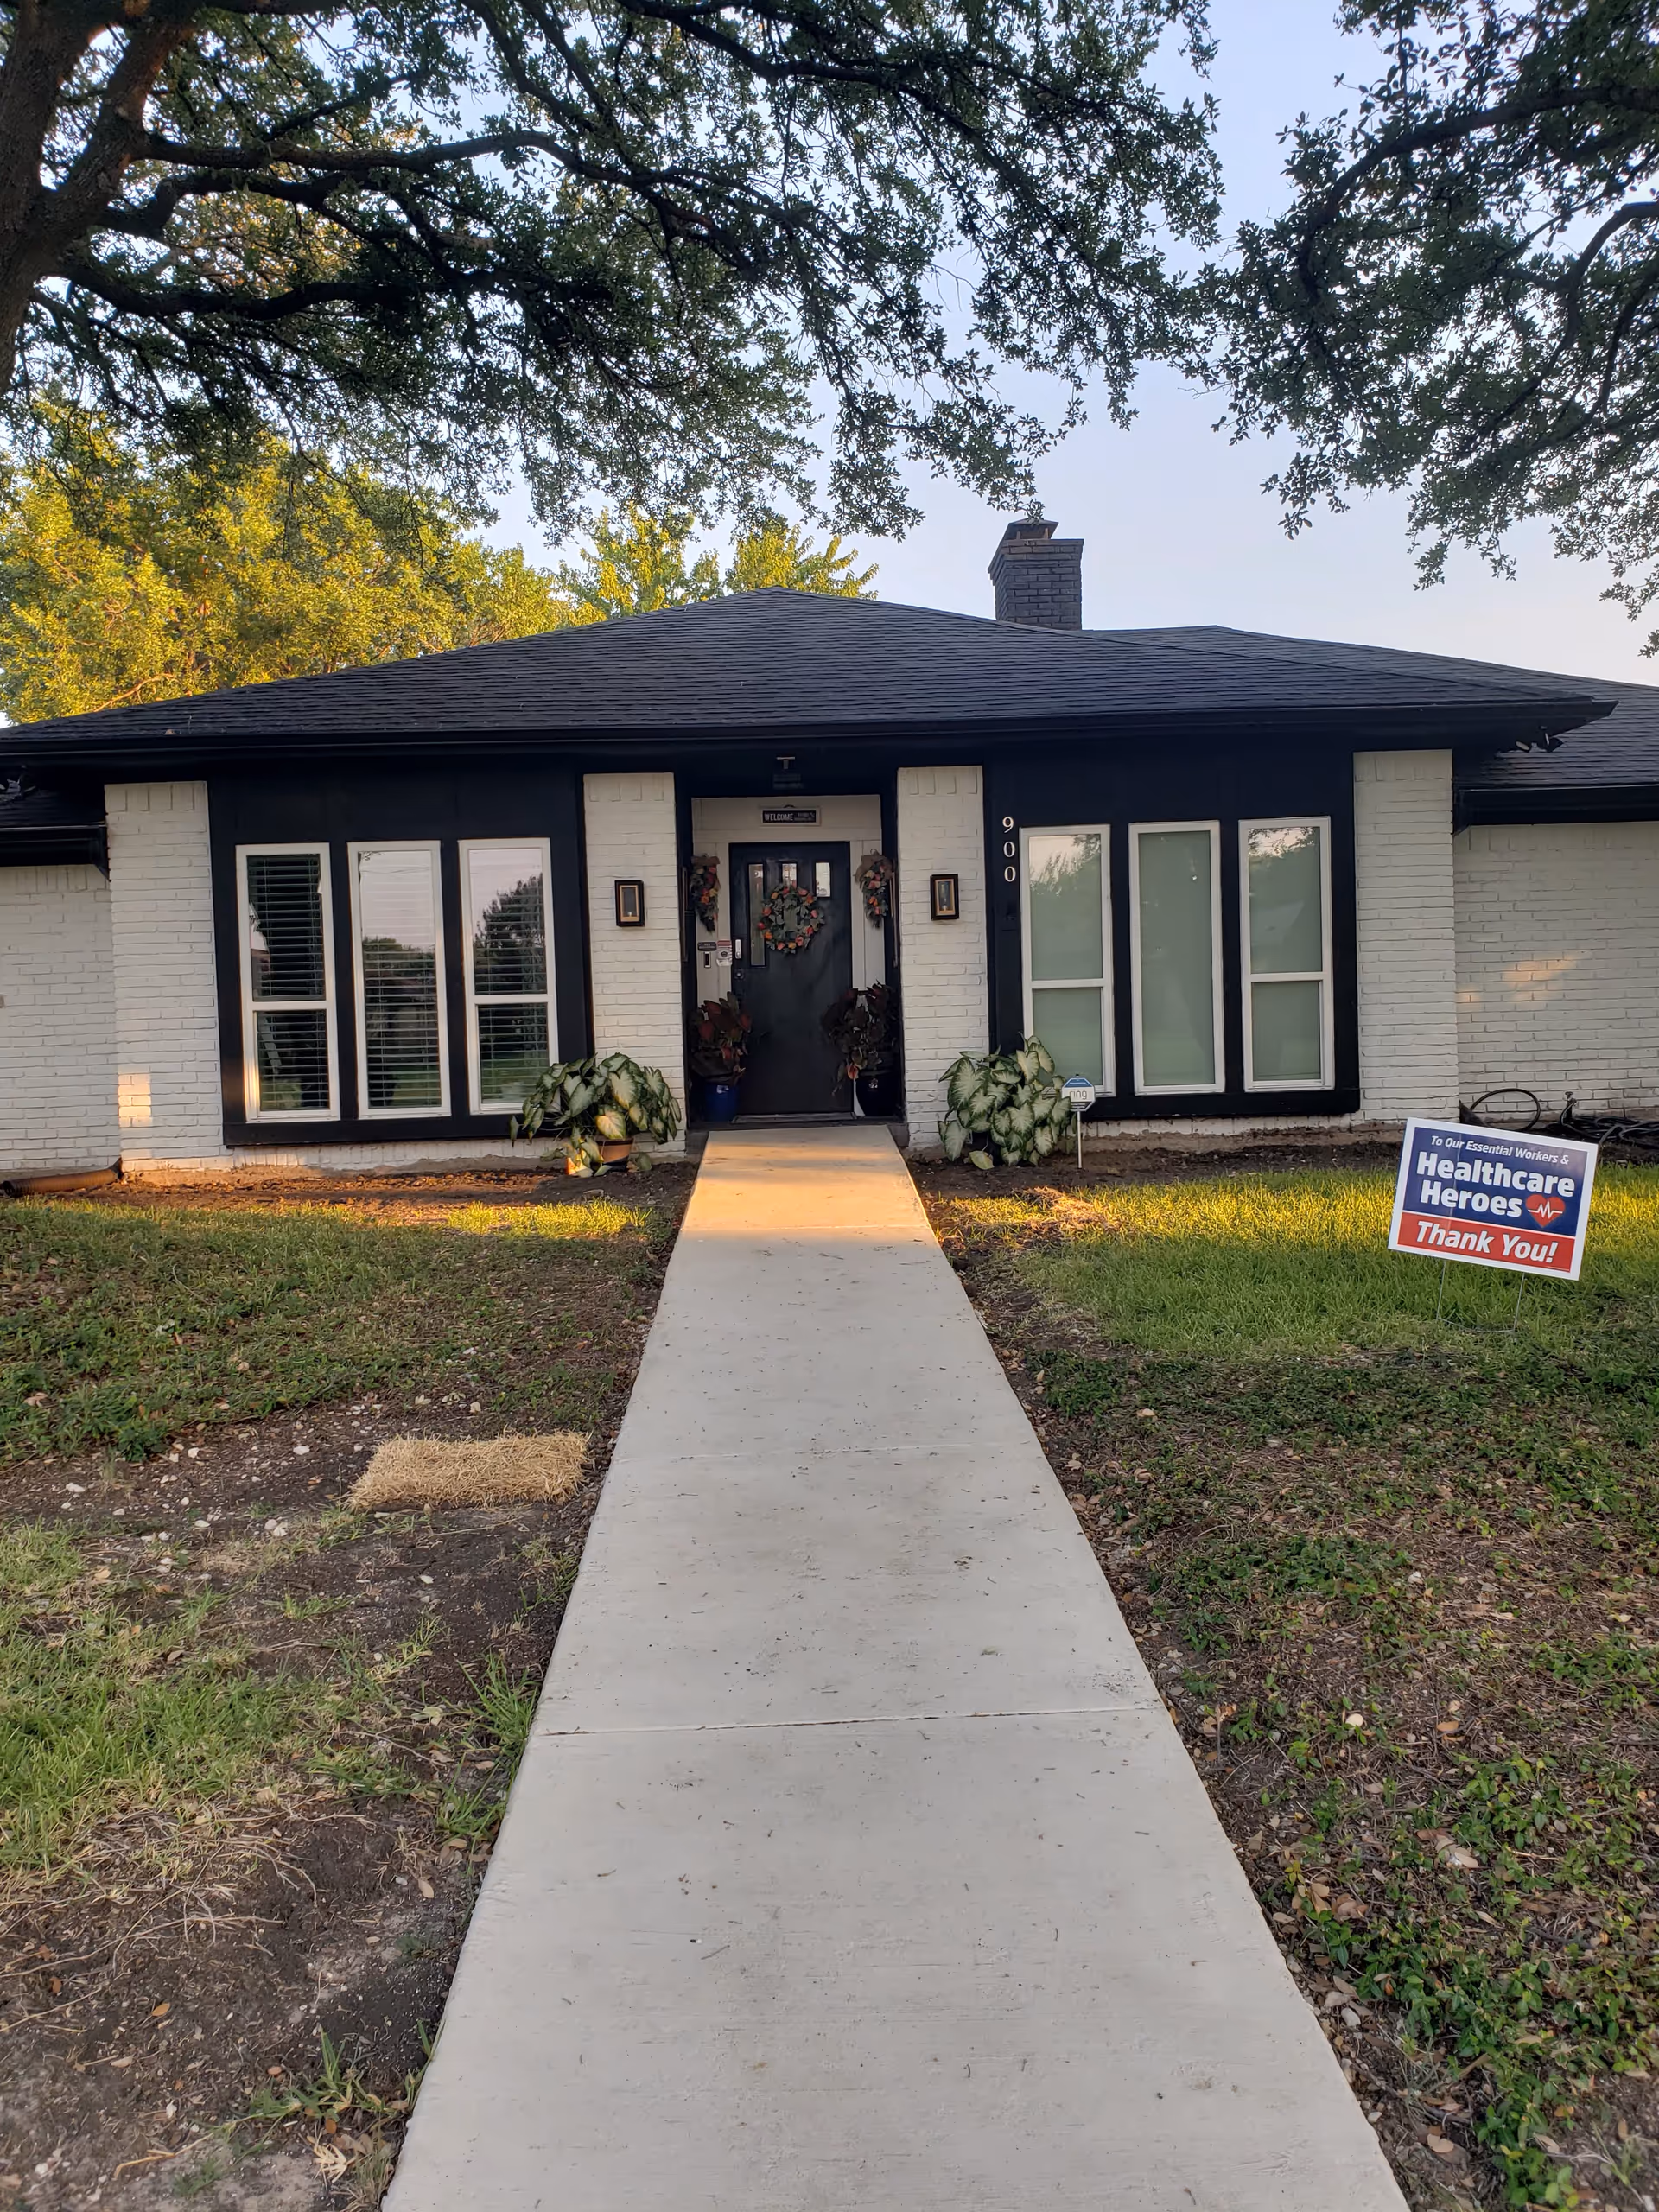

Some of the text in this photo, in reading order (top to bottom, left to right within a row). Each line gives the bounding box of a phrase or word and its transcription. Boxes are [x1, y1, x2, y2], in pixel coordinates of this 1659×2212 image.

[1002, 817, 1016, 882] 900
[1069, 1089, 1087, 1100] ring
[1431, 1135, 1570, 1165] To Our Essential Workers &
[1416, 1151, 1575, 1198] Healthcare
[1420, 1179, 1523, 1217] Heroes
[1416, 1221, 1559, 1263] Thank You!
